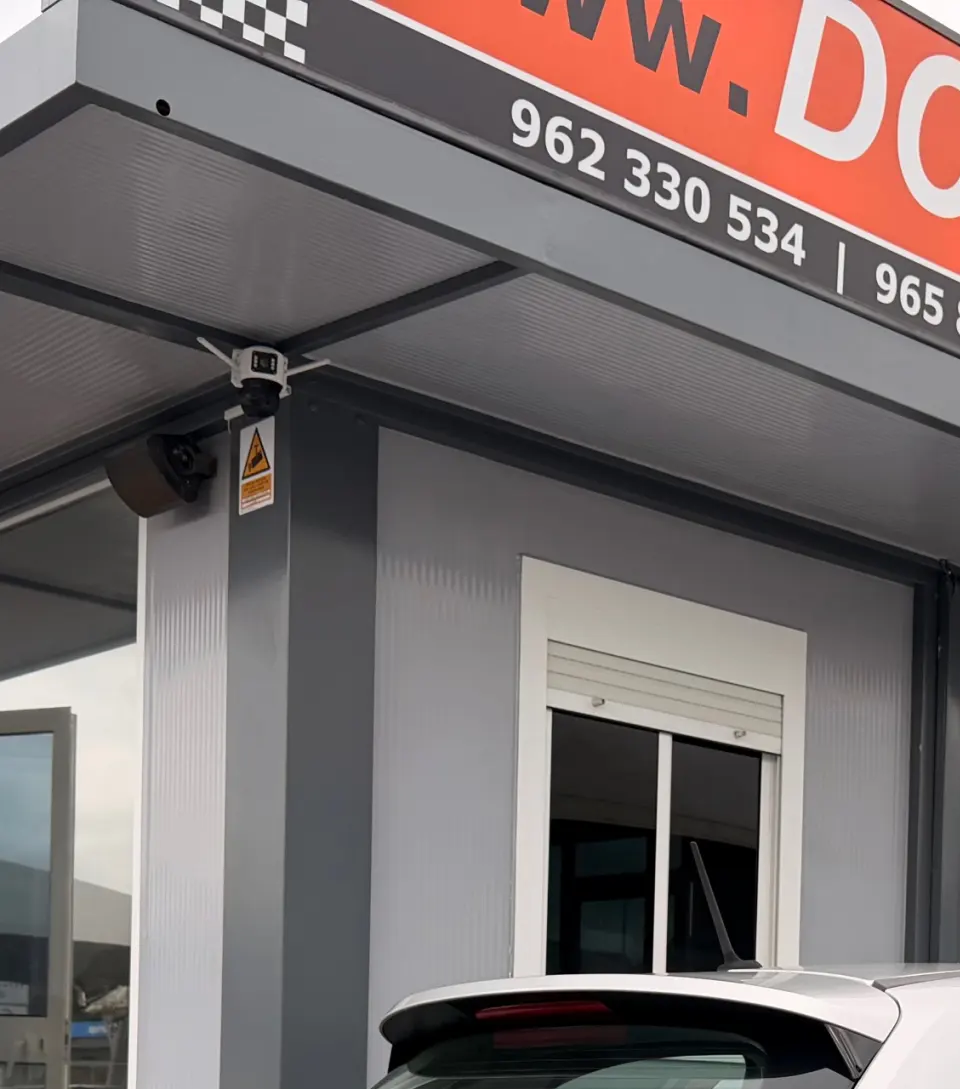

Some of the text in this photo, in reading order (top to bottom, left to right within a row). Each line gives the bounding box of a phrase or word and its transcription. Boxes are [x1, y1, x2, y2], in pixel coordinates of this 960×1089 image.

[510, 98, 606, 182] 962
[623, 148, 711, 224] 330
[726, 194, 806, 267] 534
[875, 262, 944, 326] 965
